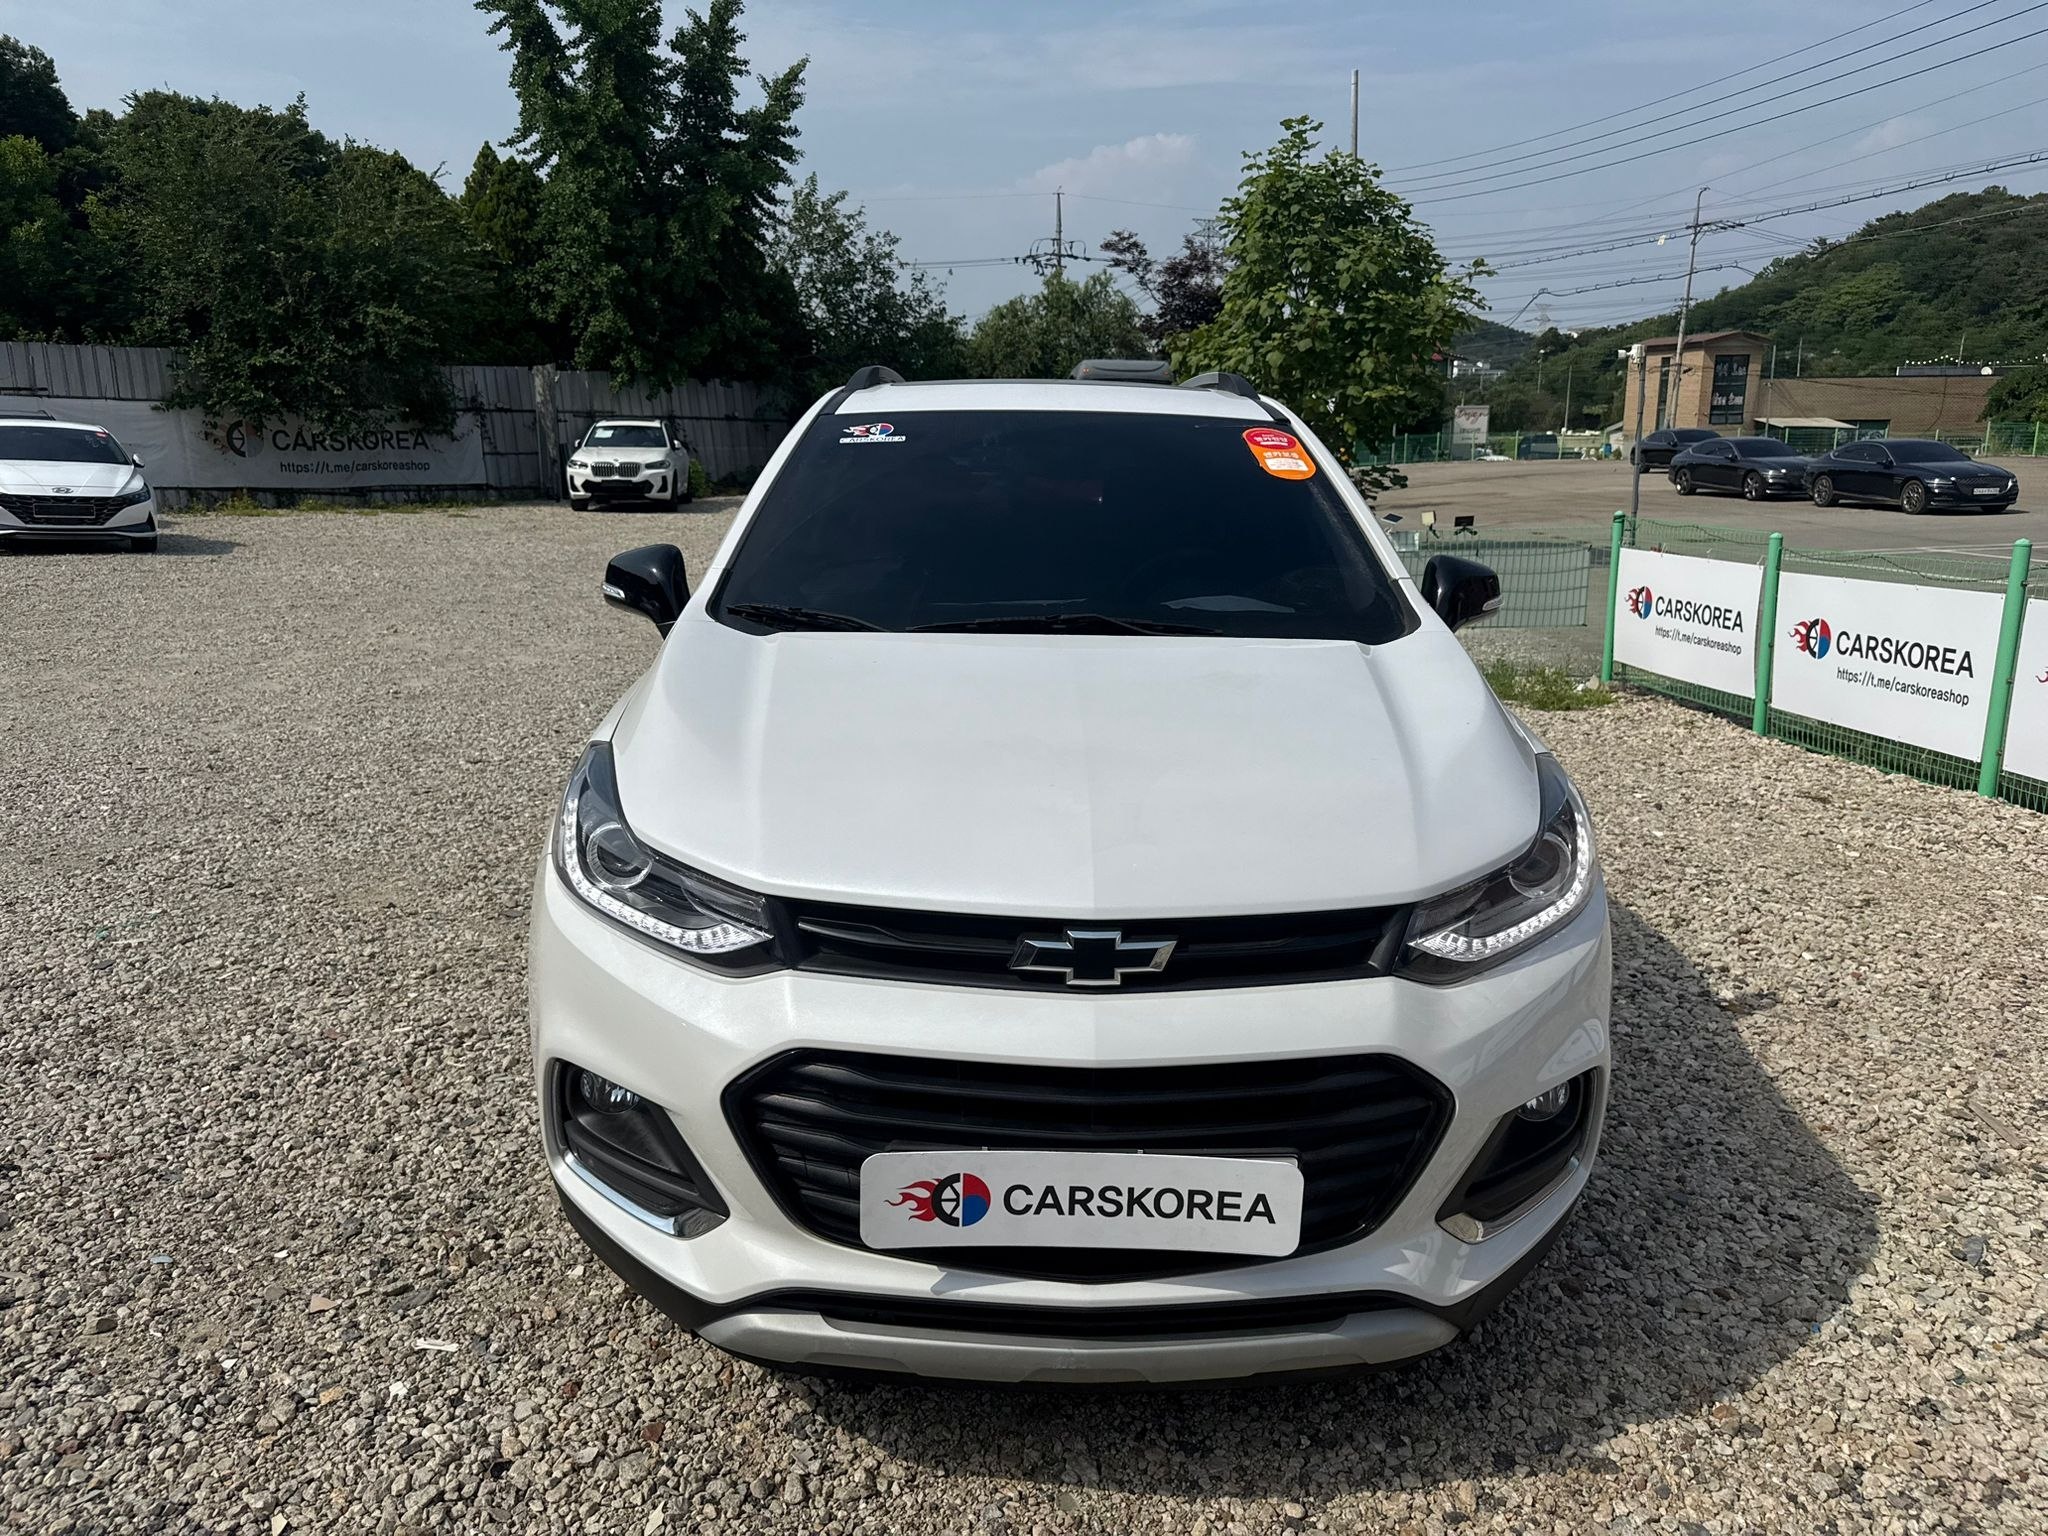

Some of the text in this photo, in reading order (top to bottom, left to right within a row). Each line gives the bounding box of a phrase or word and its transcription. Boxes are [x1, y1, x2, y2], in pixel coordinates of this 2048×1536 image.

[272, 430, 429, 451] CARSKOREA
[280, 460, 430, 475] https://t.me/carskoreashop
[1655, 596, 1743, 633] CARSKOREA
[1655, 625, 1742, 655] https://t.me/carskoreashop
[1836, 630, 1974, 678] CARSKOREA
[1836, 667, 1970, 707] https://t.me/carskoreashop
[1003, 1183, 1277, 1225] CARSKOREA
